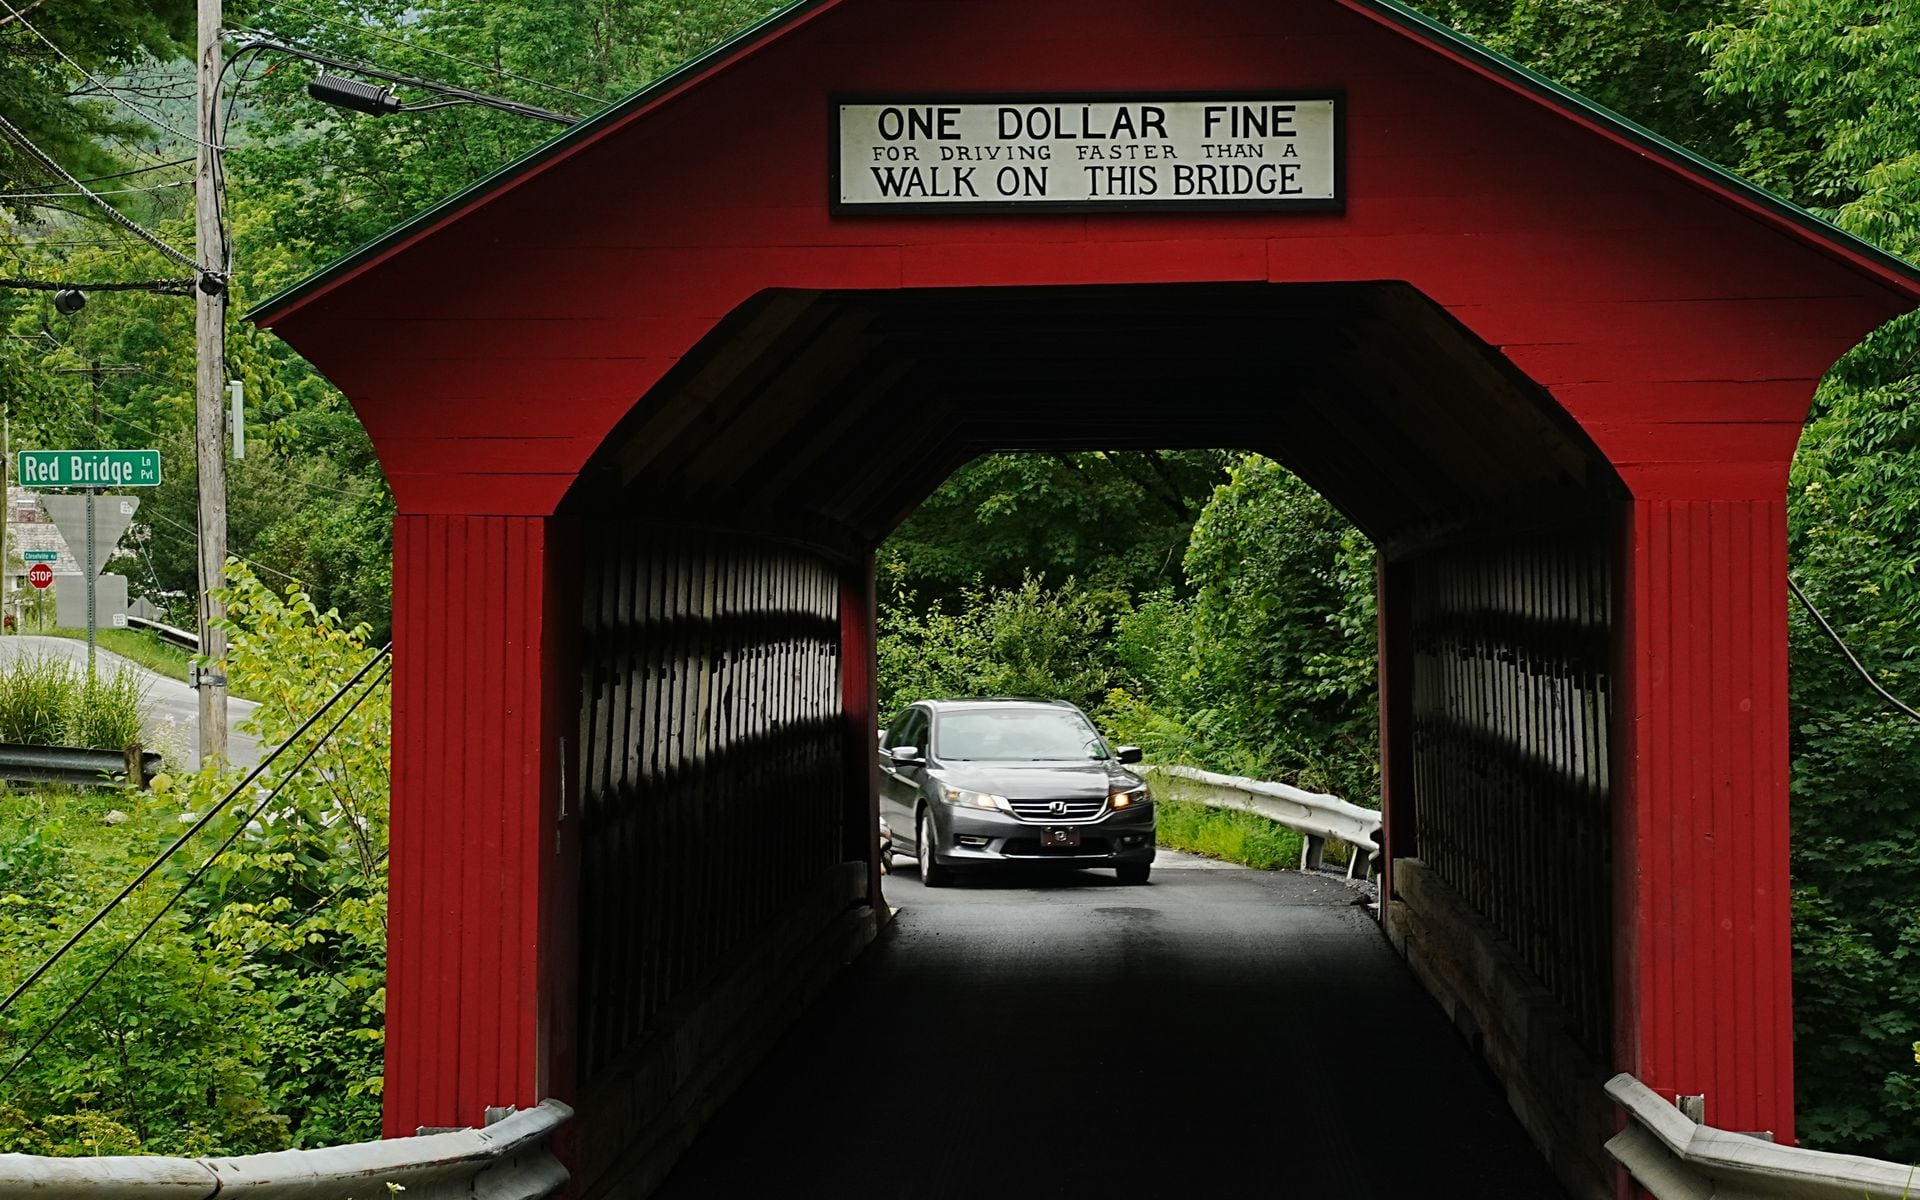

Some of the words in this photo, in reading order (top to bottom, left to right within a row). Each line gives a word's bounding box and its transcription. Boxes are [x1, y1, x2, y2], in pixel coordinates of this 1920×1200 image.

[878, 107, 961, 140] ONE
[998, 106, 1168, 140] DOLLAR
[1204, 105, 1297, 139] FINE
[872, 146, 920, 161] FOR
[939, 145, 1051, 161] DRIVING
[1075, 144, 1178, 160] FASTER
[1201, 143, 1264, 158] THAN
[1282, 143, 1298, 158] A
[870, 166, 979, 197] WALK
[996, 166, 1048, 197] ON
[1083, 165, 1158, 196] THIS
[1173, 163, 1303, 196] BRIDGE
[25, 456, 59, 481] Red
[71, 456, 132, 485] Bridge
[141, 456, 151, 467] Ln
[140, 469, 153, 480] Pvt
[30, 571, 52, 582] STOP
